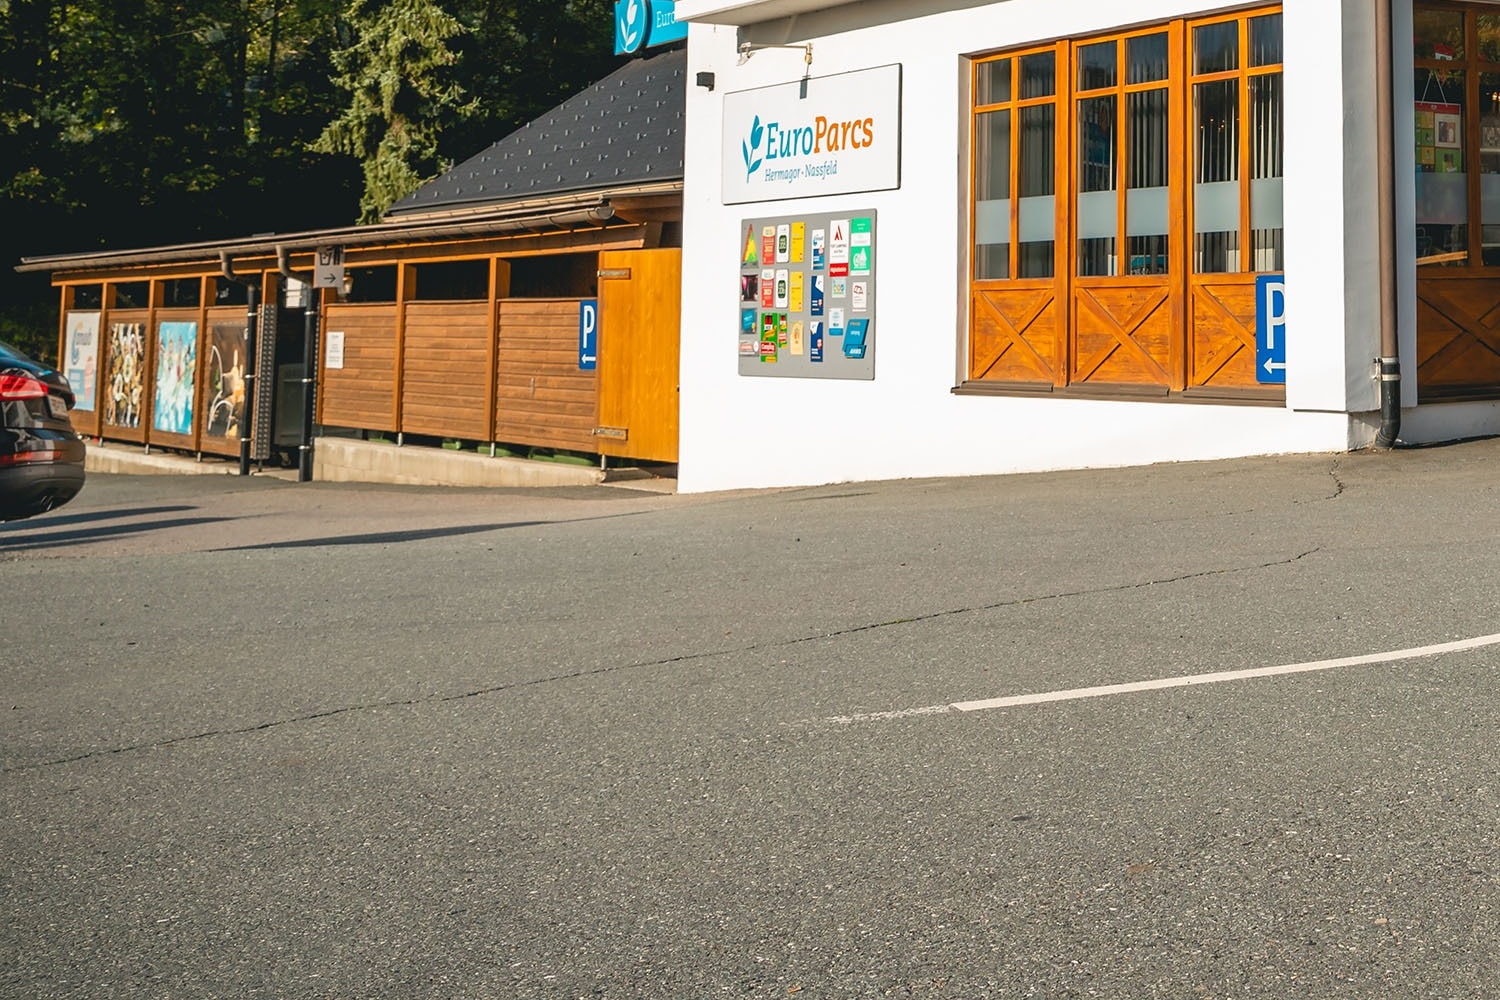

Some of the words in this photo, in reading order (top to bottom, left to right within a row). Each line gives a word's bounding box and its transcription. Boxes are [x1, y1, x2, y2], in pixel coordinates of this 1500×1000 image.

[765, 116, 873, 160] EuroParcs
[764, 167, 800, 183] Hermagor
[805, 160, 838, 180] Nassfeld
[583, 305, 595, 349] P
[1266, 282, 1285, 349] P
